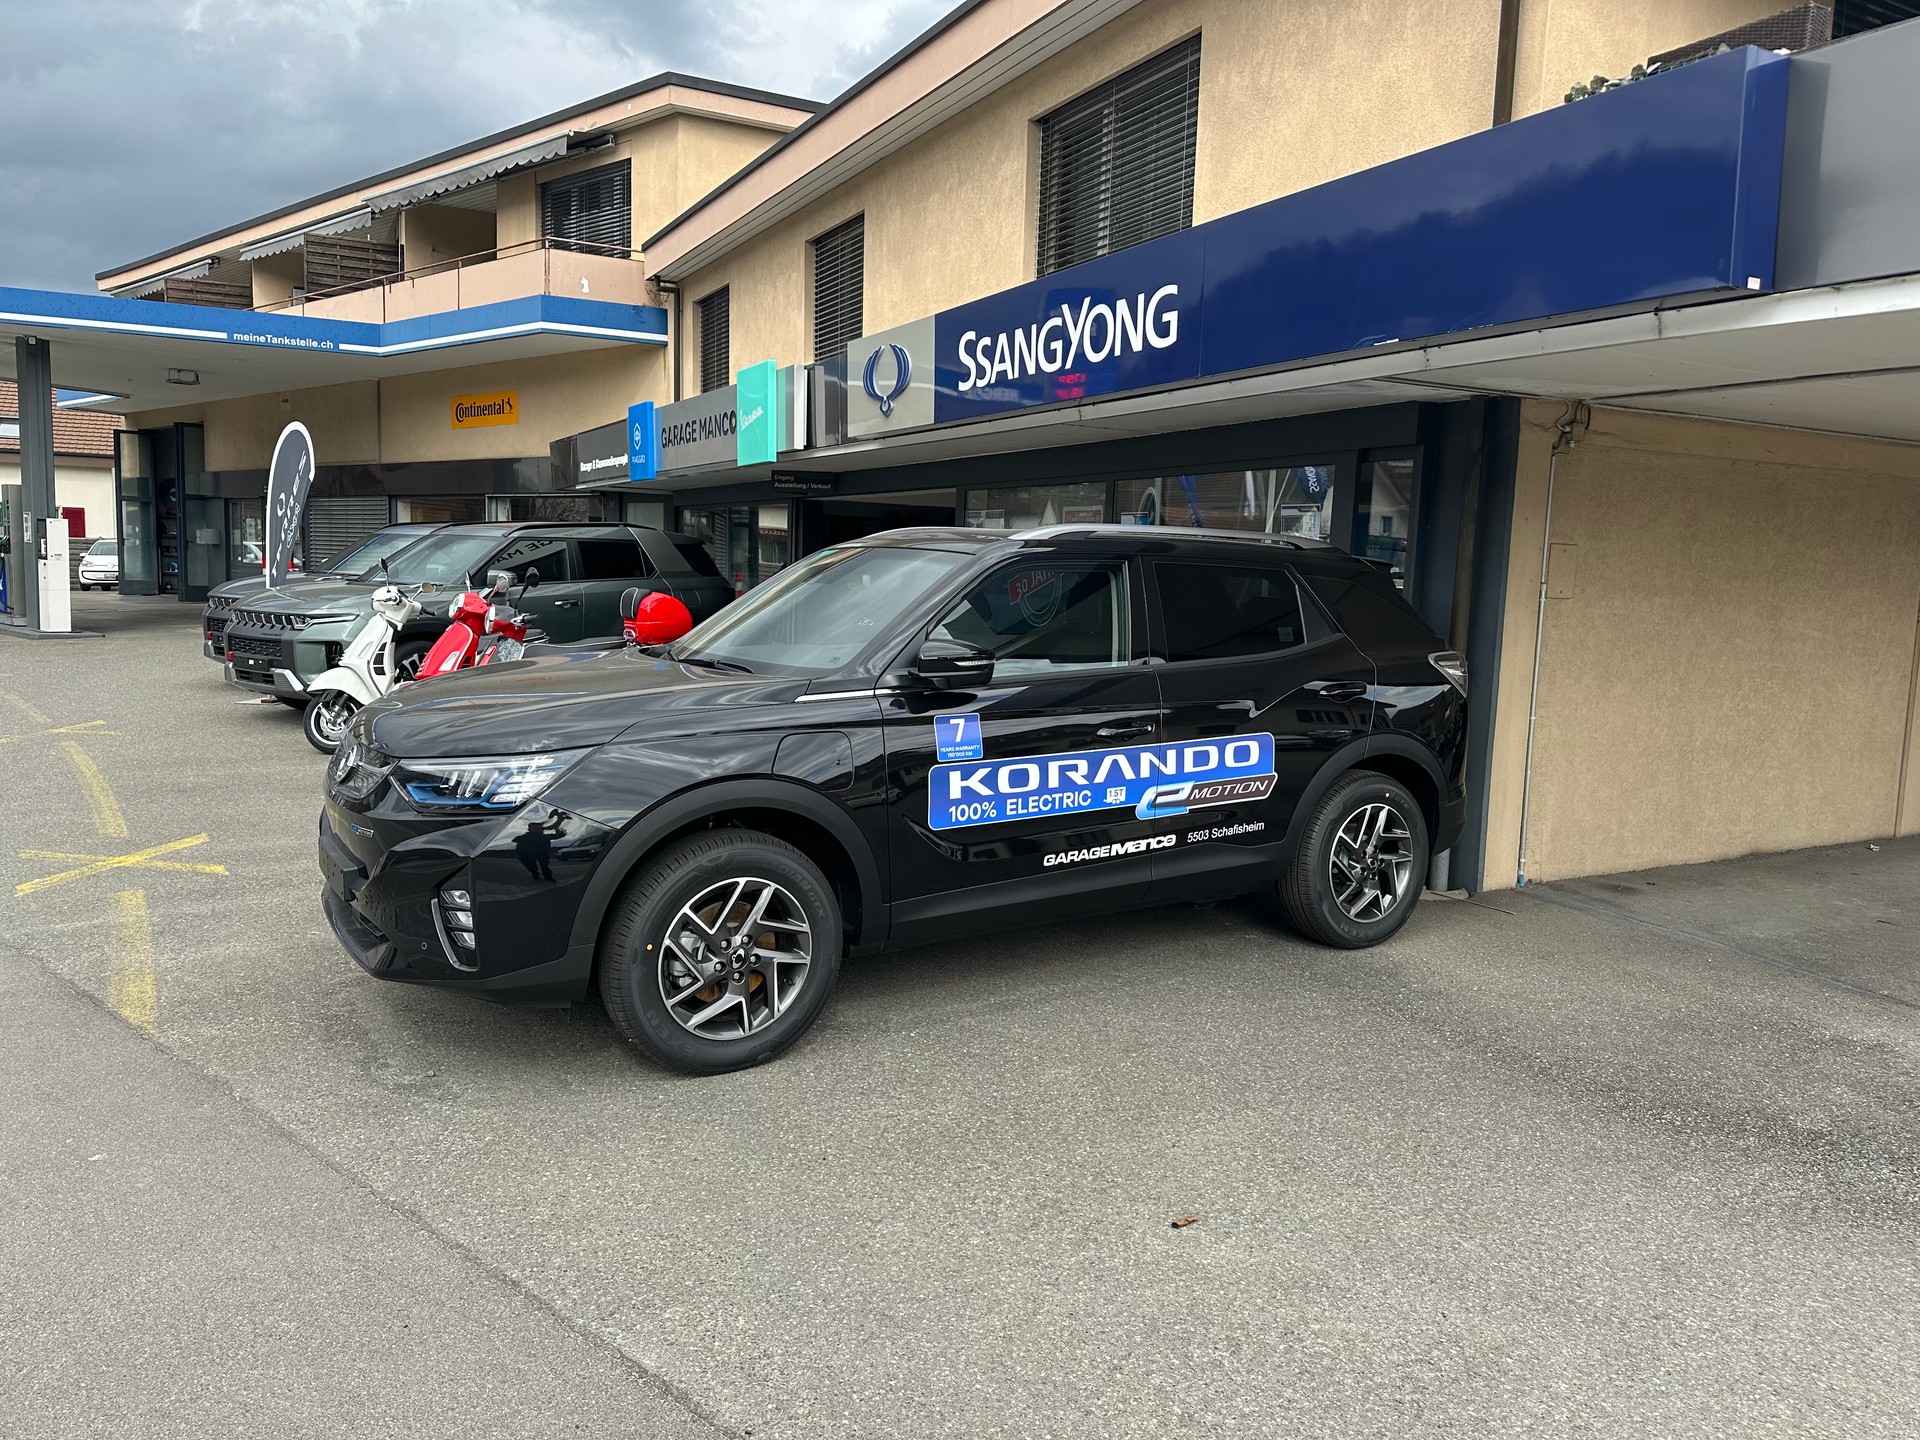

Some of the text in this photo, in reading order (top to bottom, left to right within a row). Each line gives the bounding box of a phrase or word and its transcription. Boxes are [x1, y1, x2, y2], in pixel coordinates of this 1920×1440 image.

[233, 332, 334, 349] meineTankstelle.ch
[958, 284, 1179, 391] SSANGYONG
[455, 398, 505, 423] Continental
[740, 406, 763, 431] Vespa
[661, 409, 737, 449] GARAGE MANCO
[632, 454, 646, 464] PIAGGIO
[774, 482, 807, 490] Ausstellung
[949, 718, 965, 743] 7
[955, 744, 981, 752] WARRANTY
[949, 739, 1261, 800] KORANDO
[1108, 787, 1125, 798] 1.5T
[1190, 779, 1269, 801] MOTION
[948, 789, 1092, 823] 100% ELECTRIC
[1187, 830, 1209, 843] 5503
[1211, 821, 1265, 839] Schafisheim
